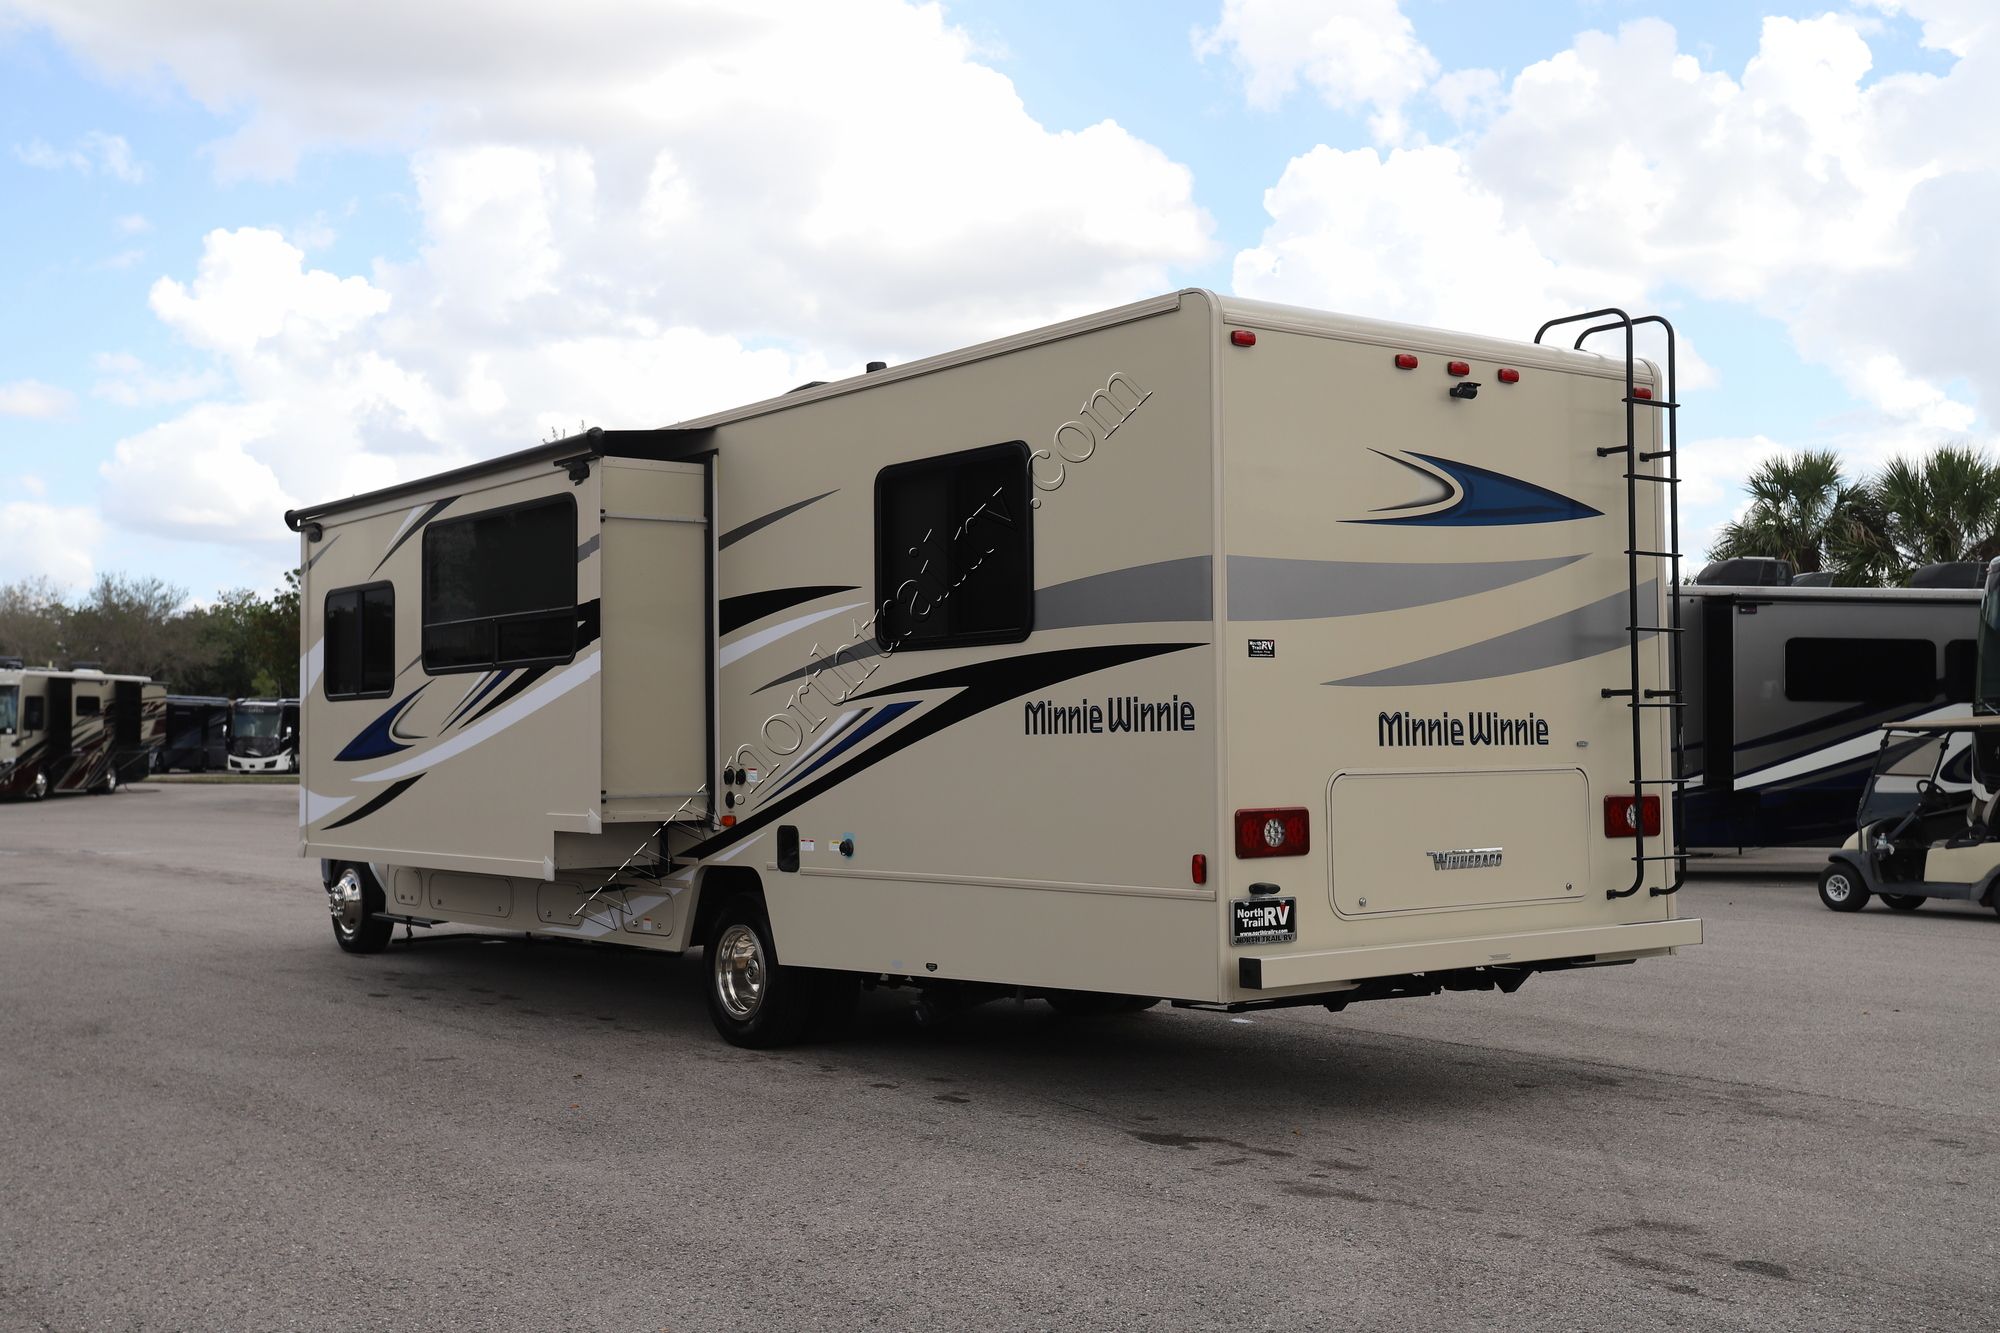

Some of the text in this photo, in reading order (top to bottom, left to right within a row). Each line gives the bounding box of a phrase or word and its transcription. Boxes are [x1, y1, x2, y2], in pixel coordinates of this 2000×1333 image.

[1262, 641, 1273, 650] RV
[1025, 695, 1195, 735] Minnie Winnie
[1379, 712, 1549, 746] Minnie Winnie
[1237, 908, 1263, 918] North
[1264, 906, 1290, 926] RV
[1242, 918, 1263, 928] Trail
